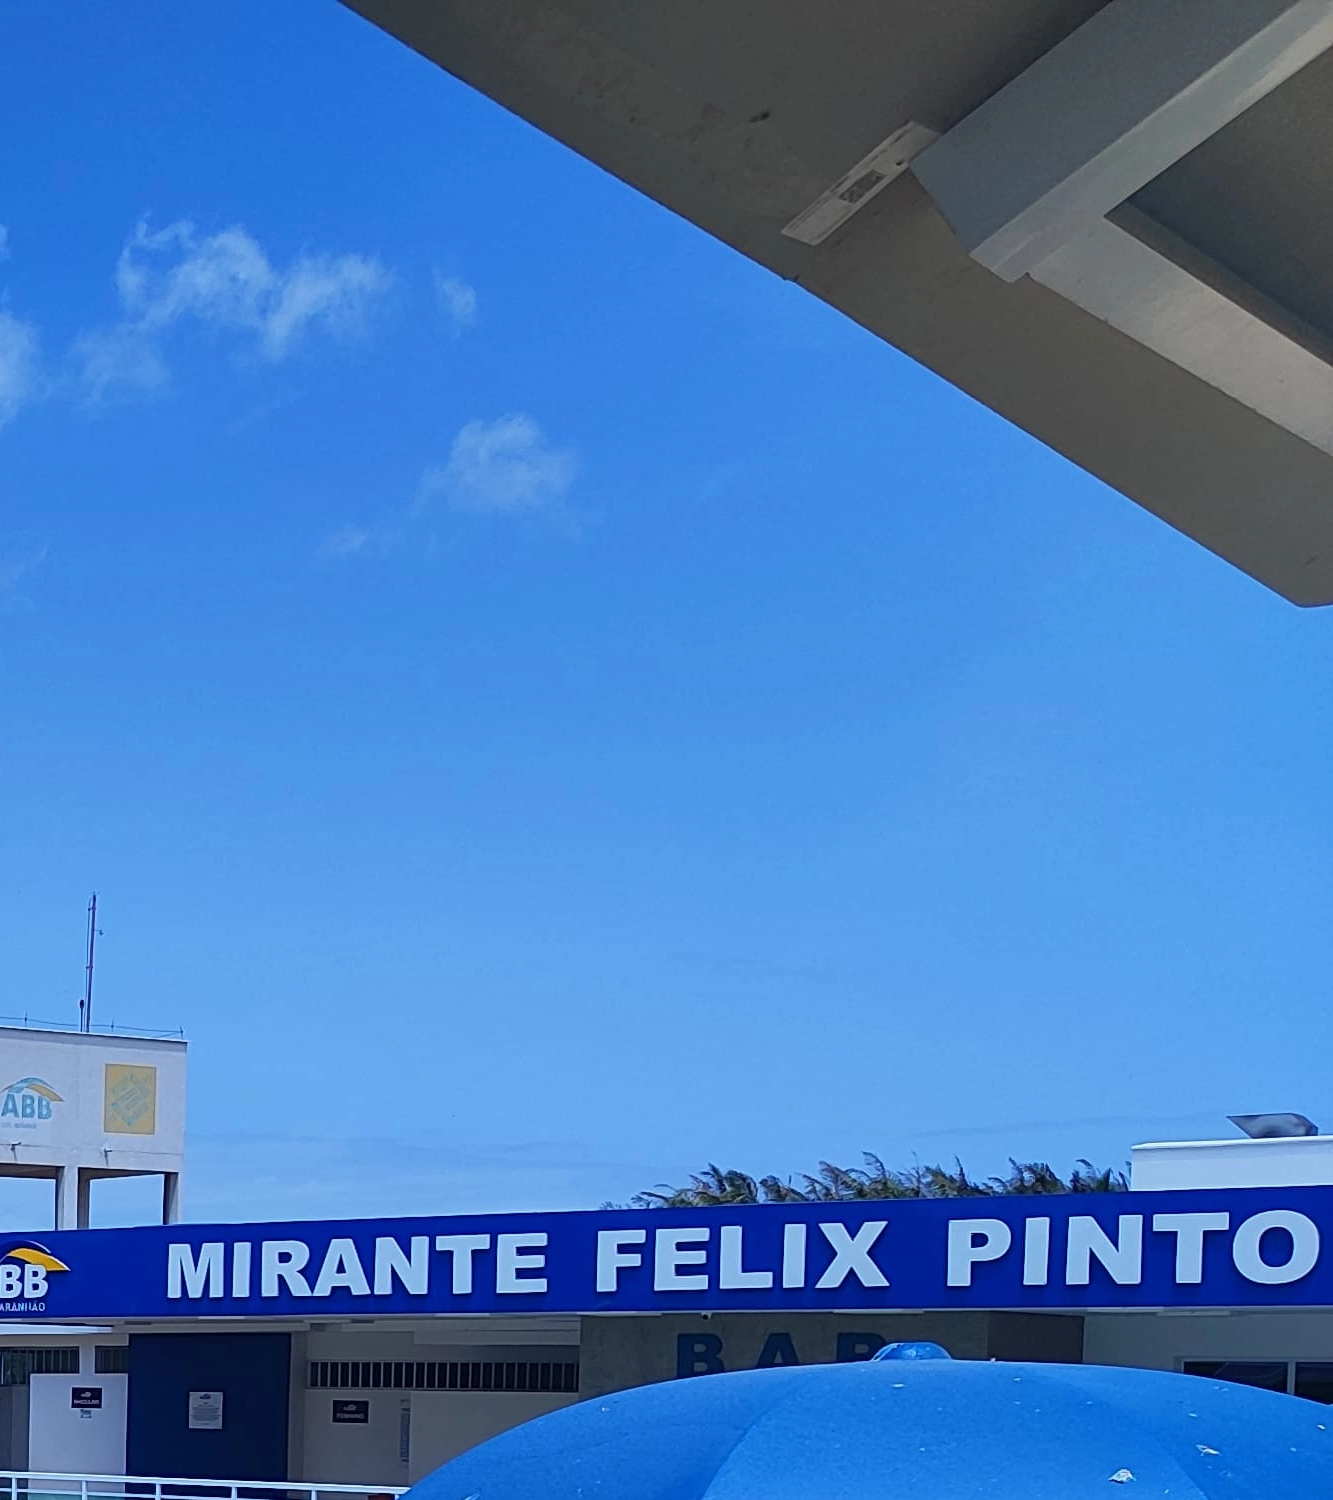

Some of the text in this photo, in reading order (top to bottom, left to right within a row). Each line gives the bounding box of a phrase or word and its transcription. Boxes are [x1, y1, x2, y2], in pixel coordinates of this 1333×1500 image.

[166, 1208, 1321, 1299] MIRANTE FELIX PINTO
